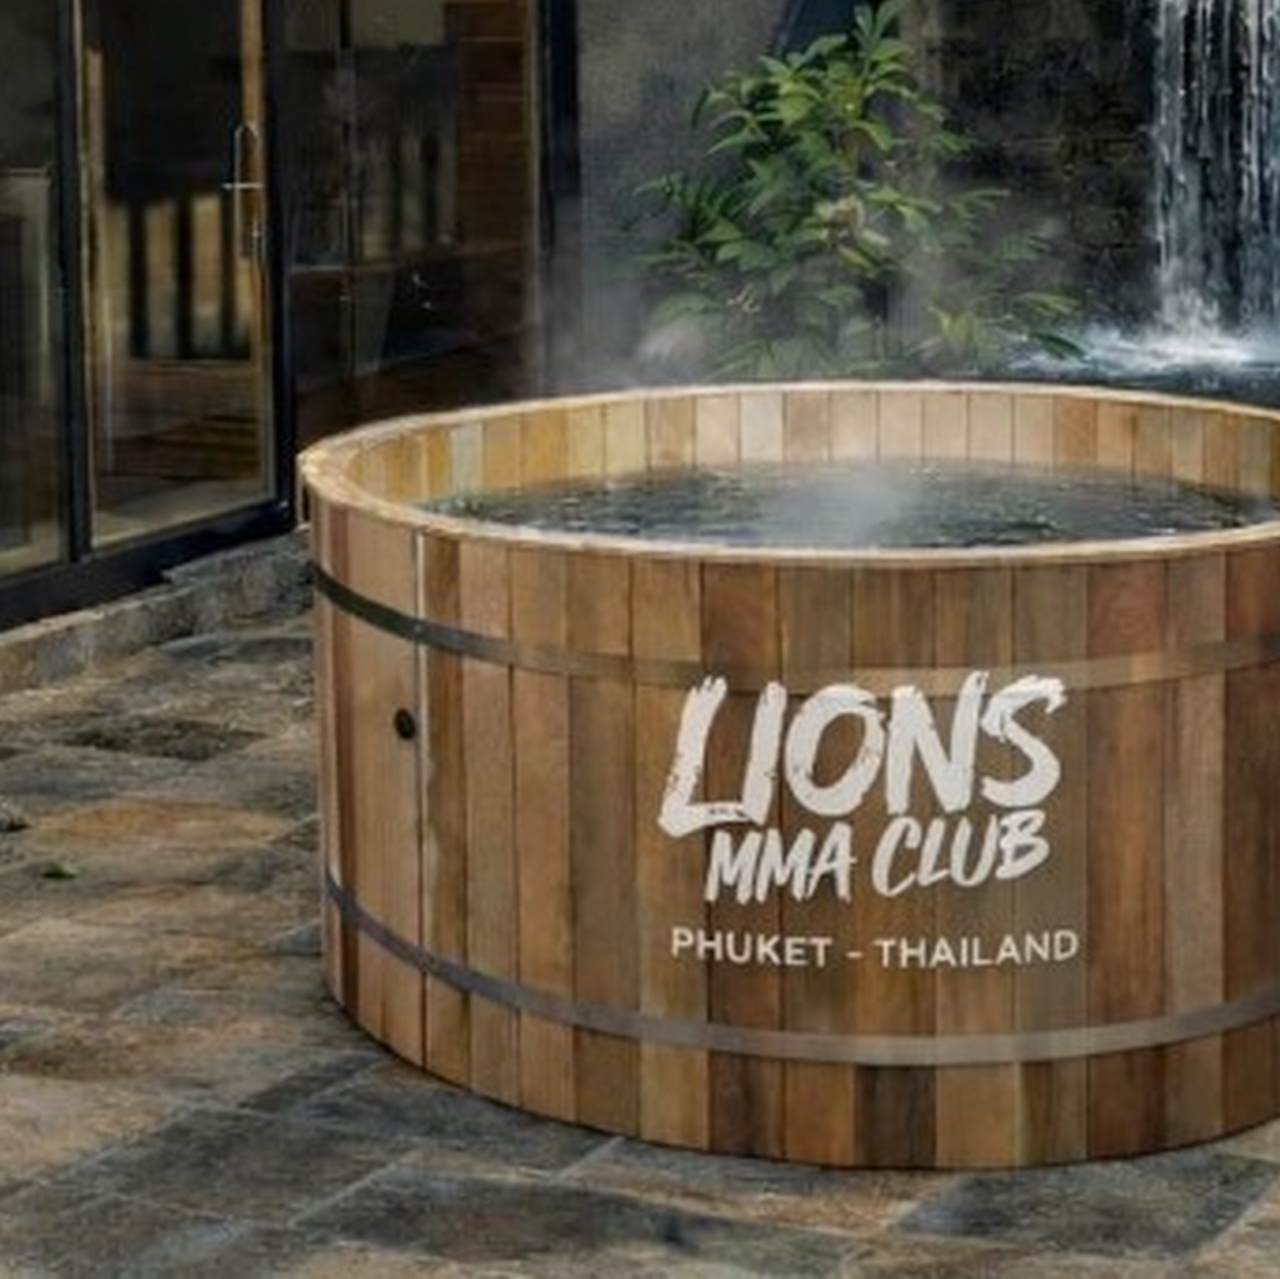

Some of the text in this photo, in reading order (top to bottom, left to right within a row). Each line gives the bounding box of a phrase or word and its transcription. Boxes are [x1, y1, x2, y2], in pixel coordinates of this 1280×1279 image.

[658, 670, 1067, 838] LIONS
[705, 808, 1050, 905] MMA CLUB
[671, 927, 833, 968] PHUKET
[874, 929, 1079, 969] THAILAND
